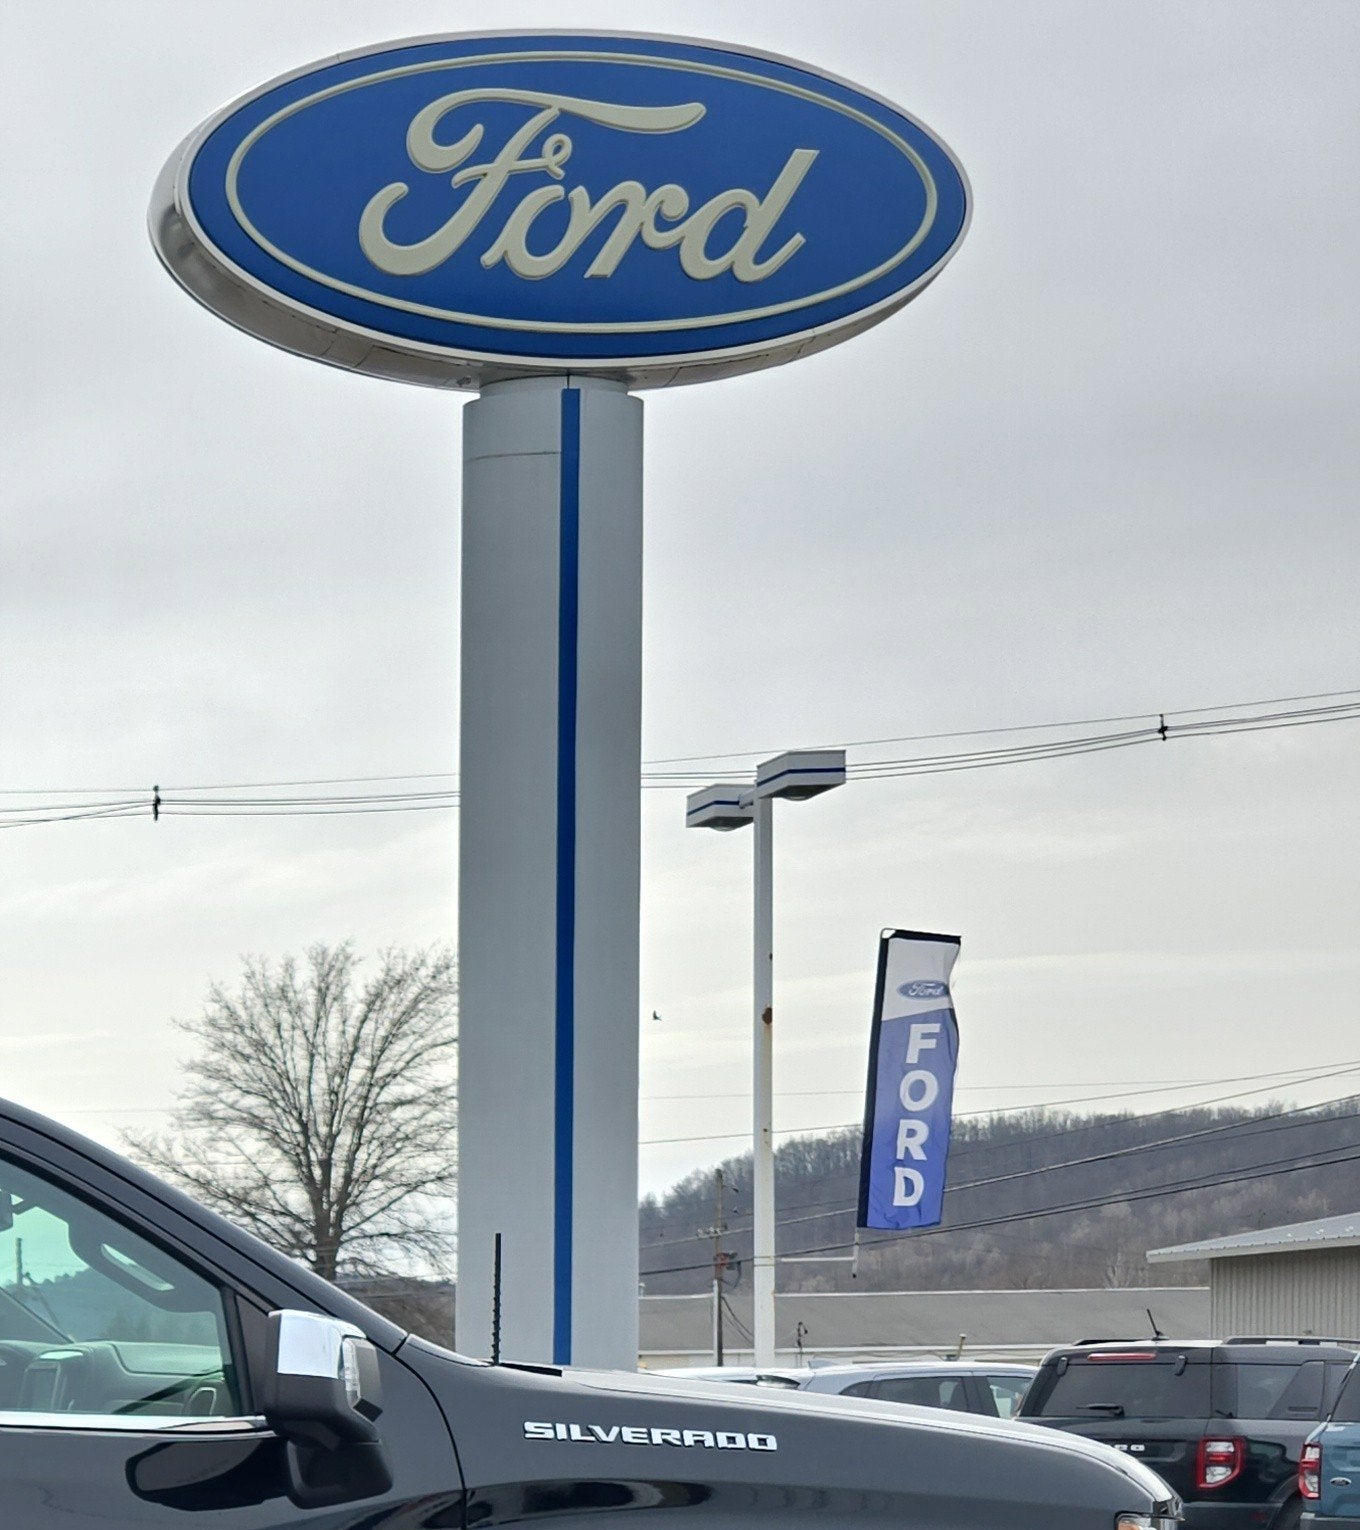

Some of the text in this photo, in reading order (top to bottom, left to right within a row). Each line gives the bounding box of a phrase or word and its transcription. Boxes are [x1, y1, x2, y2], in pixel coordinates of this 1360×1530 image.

[359, 89, 819, 282] Ford
[908, 982, 944, 996] Ford
[893, 1023, 940, 1206] FORD
[524, 1421, 777, 1451] SILVERADO
